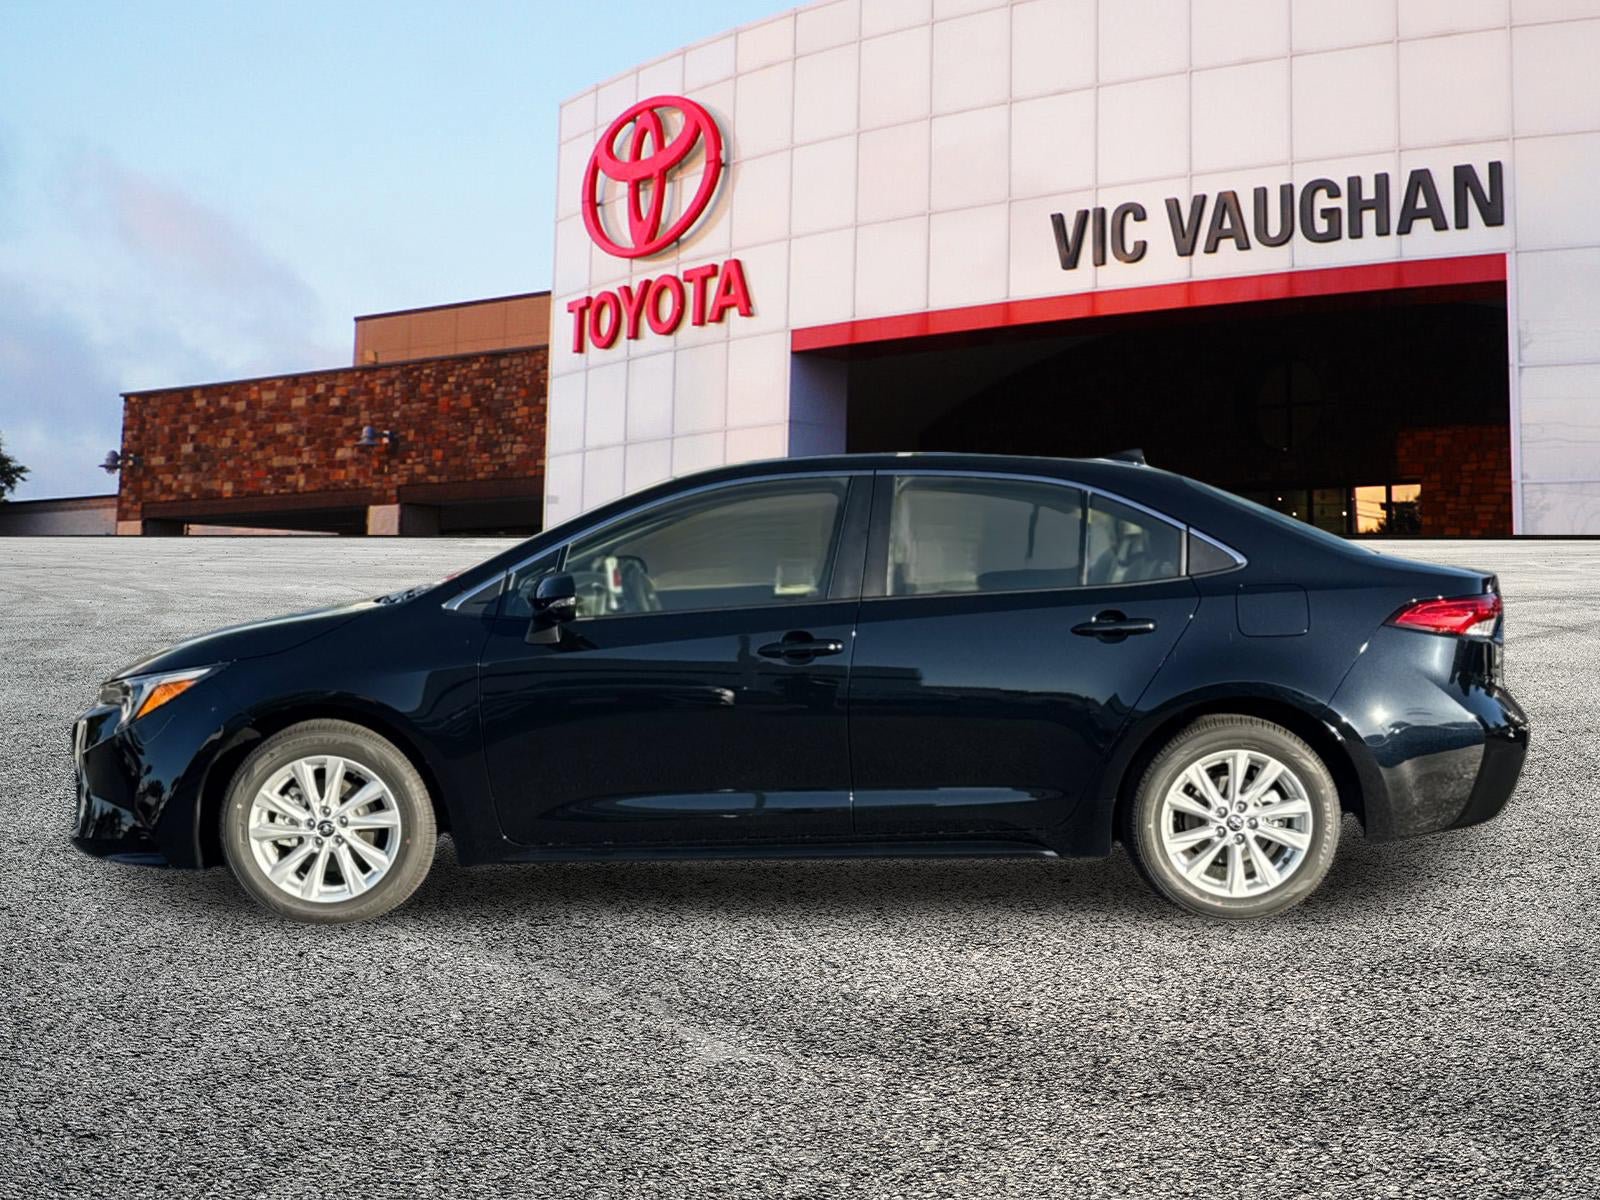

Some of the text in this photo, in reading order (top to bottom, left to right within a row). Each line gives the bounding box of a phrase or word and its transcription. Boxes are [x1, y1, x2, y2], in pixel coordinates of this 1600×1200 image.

[1050, 161, 1505, 270] VIC VAUGHAN
[567, 258, 754, 353] TOYOTA
